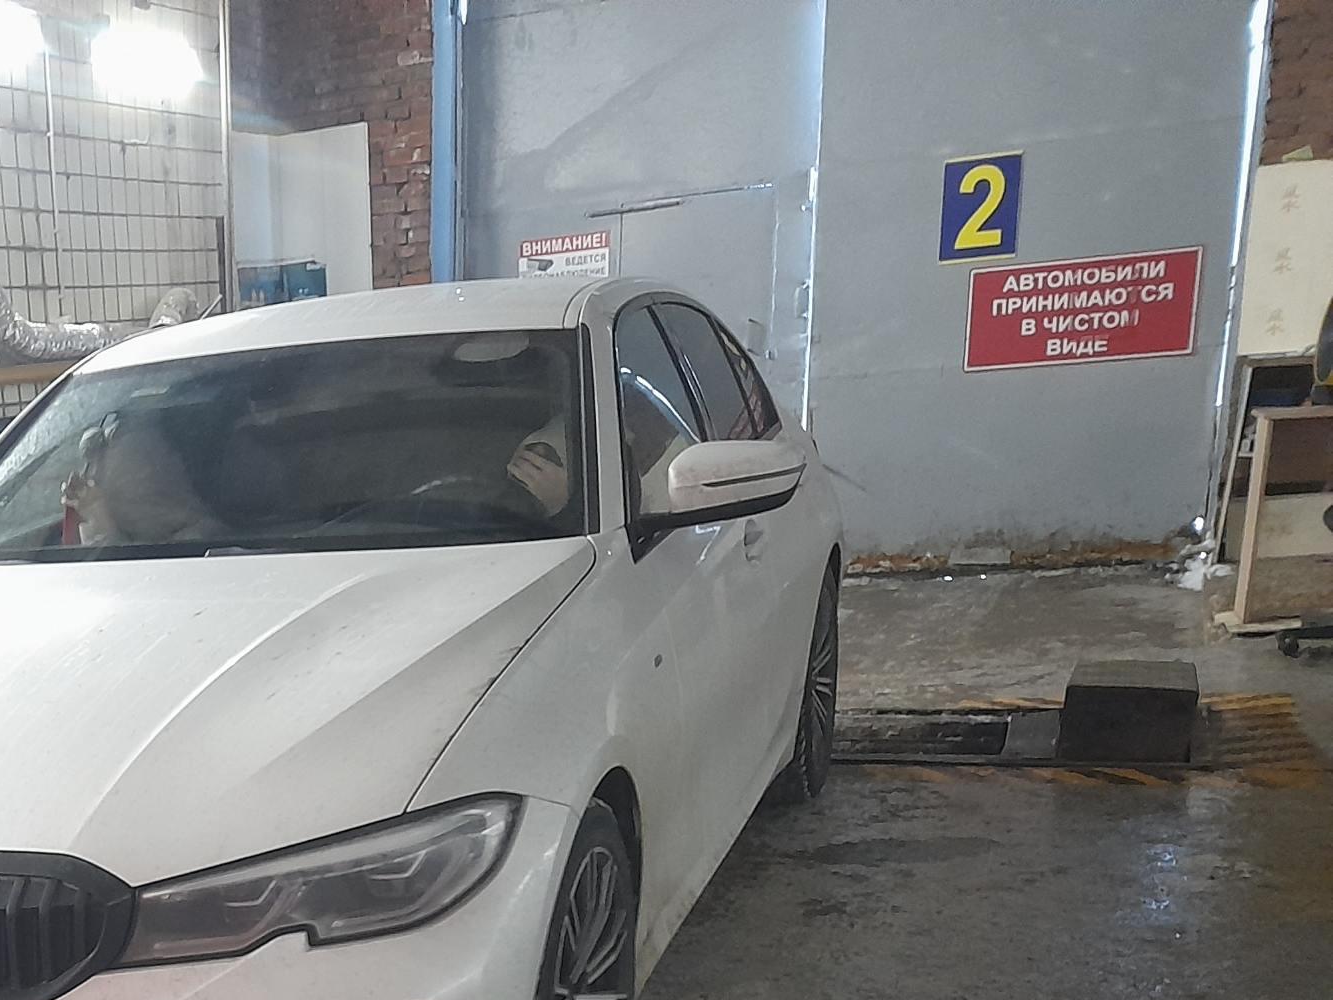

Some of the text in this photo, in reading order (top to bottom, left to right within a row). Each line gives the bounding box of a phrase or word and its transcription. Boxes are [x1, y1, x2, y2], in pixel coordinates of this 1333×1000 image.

[954, 163, 1006, 250] 2
[522, 232, 606, 257] ВНИМАНИЕ!
[1002, 260, 1167, 293] АВТОМОБИЛИ
[1020, 309, 1140, 336] В ЧИСТОМ
[1045, 335, 1110, 357] ВИДЕ
